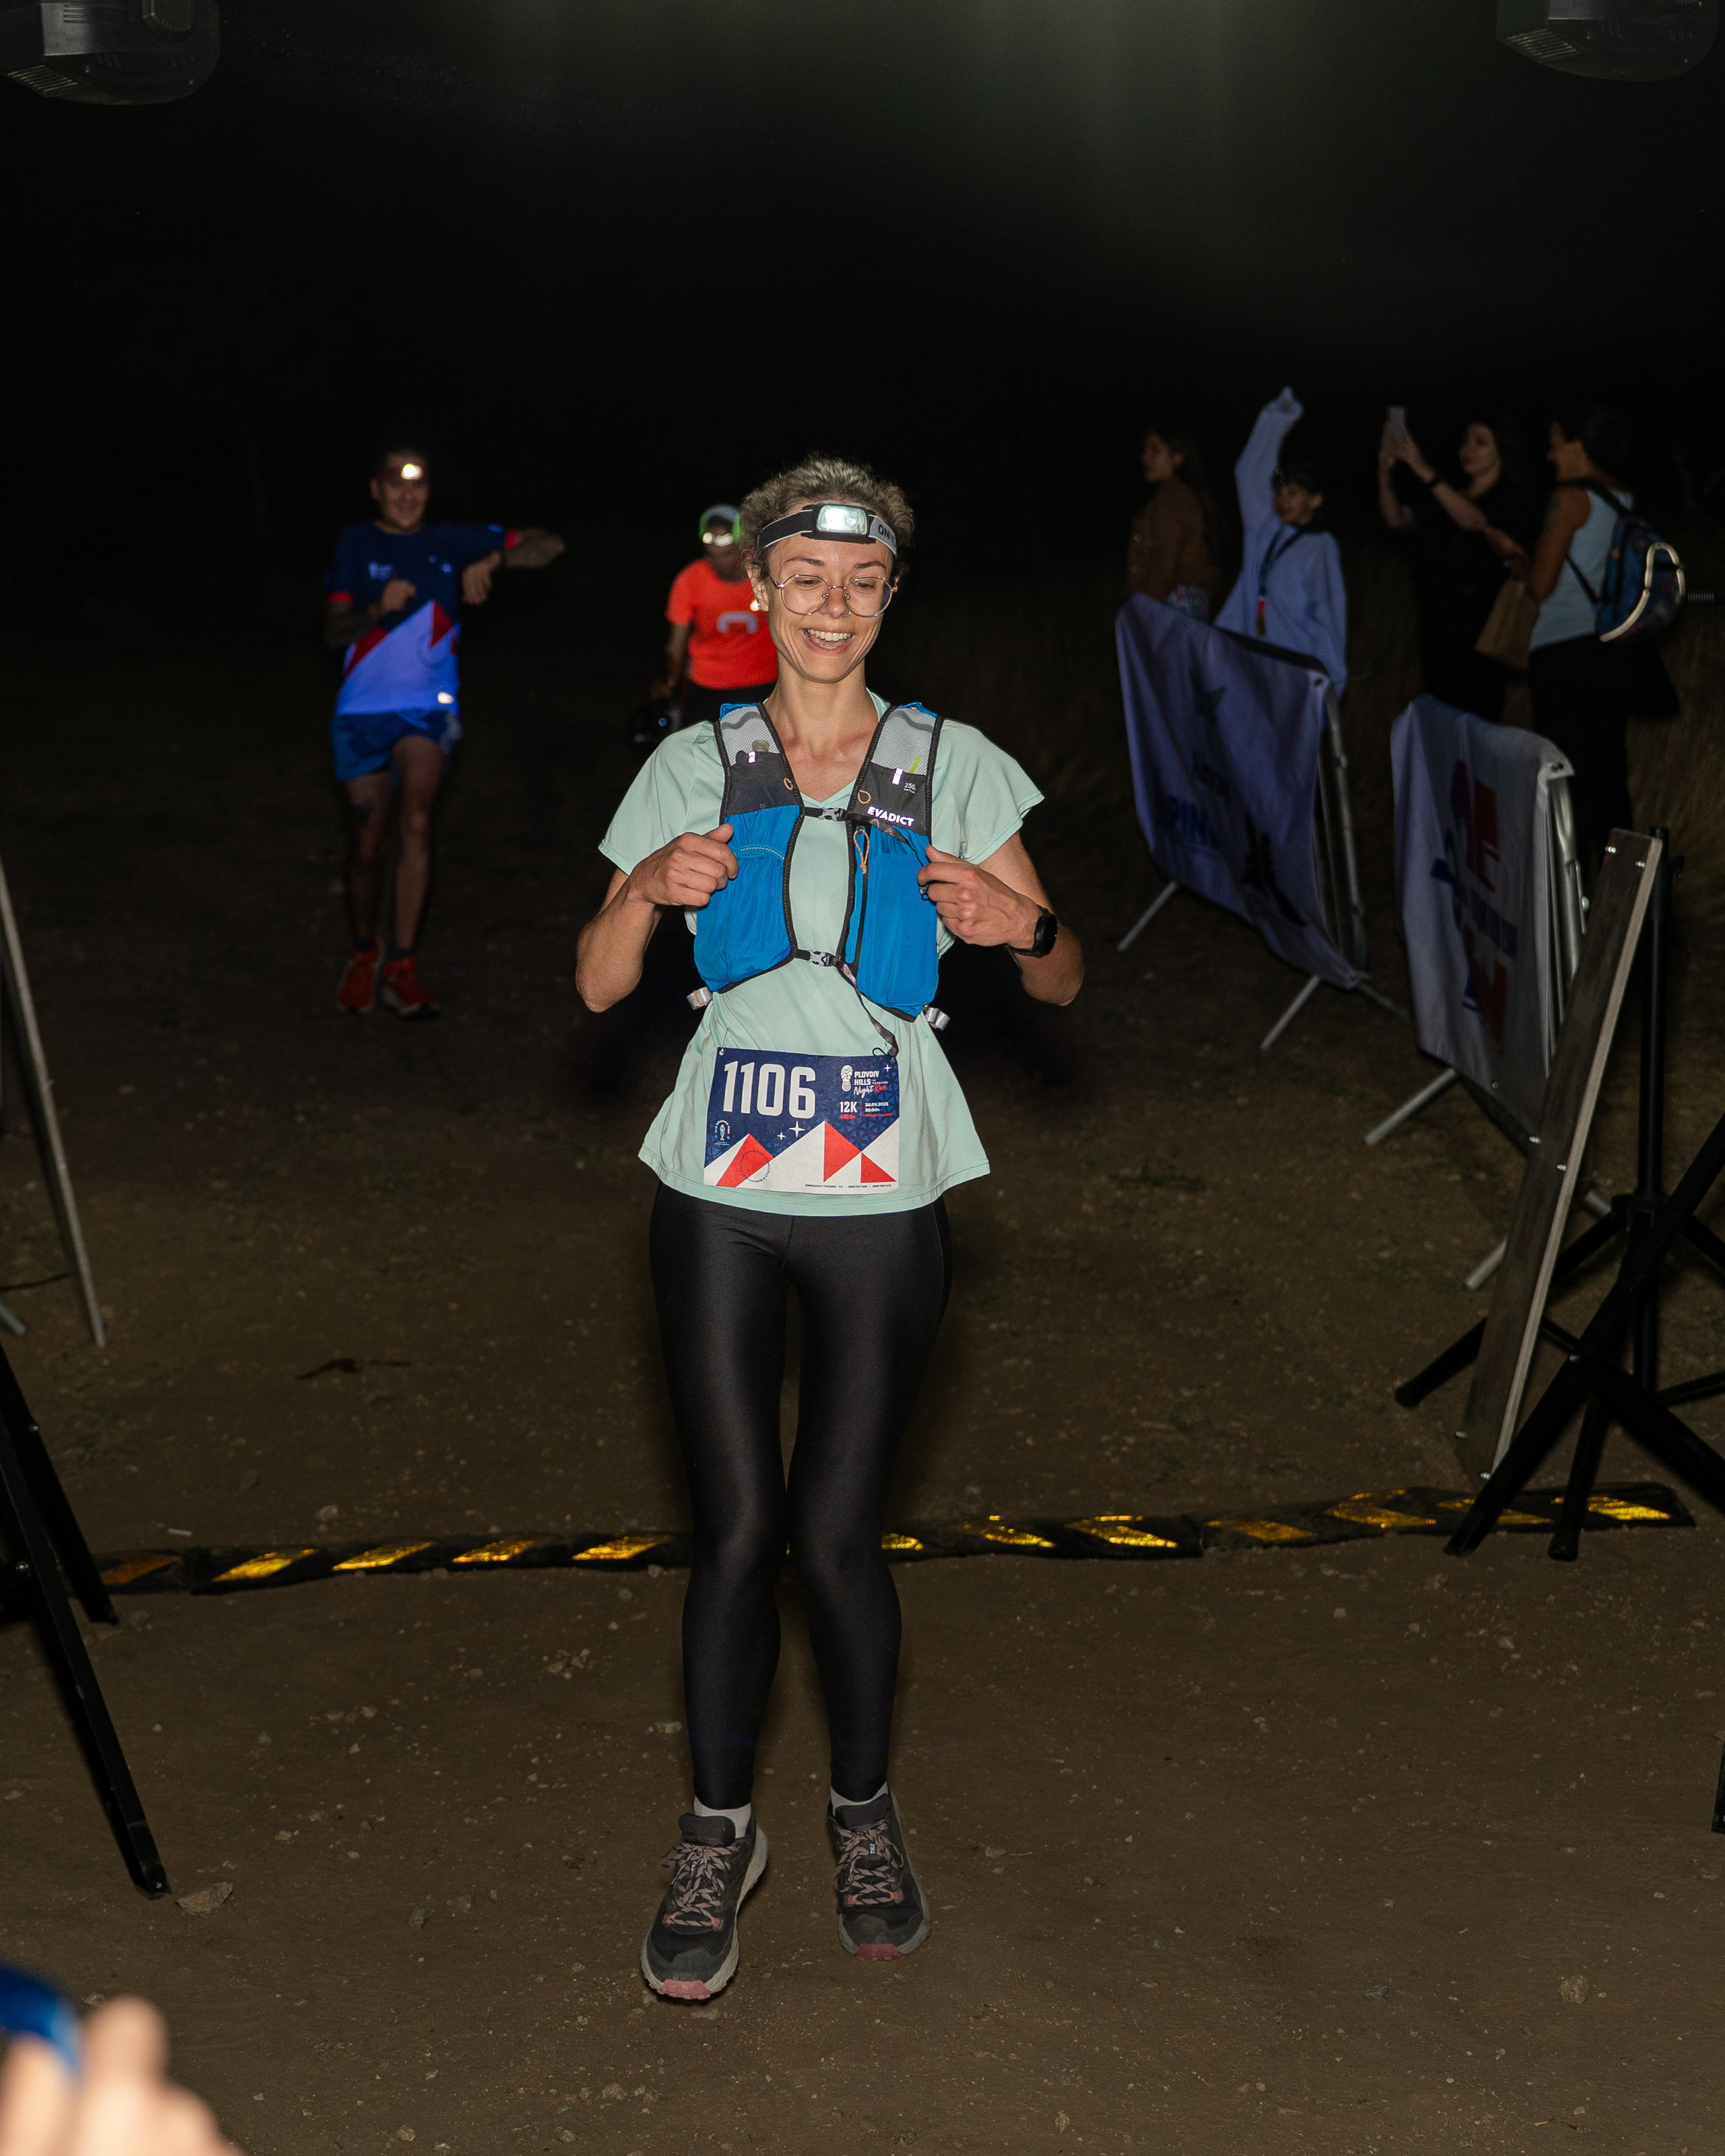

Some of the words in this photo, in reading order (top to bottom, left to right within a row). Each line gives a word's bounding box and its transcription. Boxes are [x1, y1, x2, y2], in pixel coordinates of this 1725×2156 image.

[867, 806, 914, 827] EVADICT
[723, 1060, 816, 1119] 1106
[853, 1085, 874, 1099] Night
[840, 1101, 858, 1113] 12K
